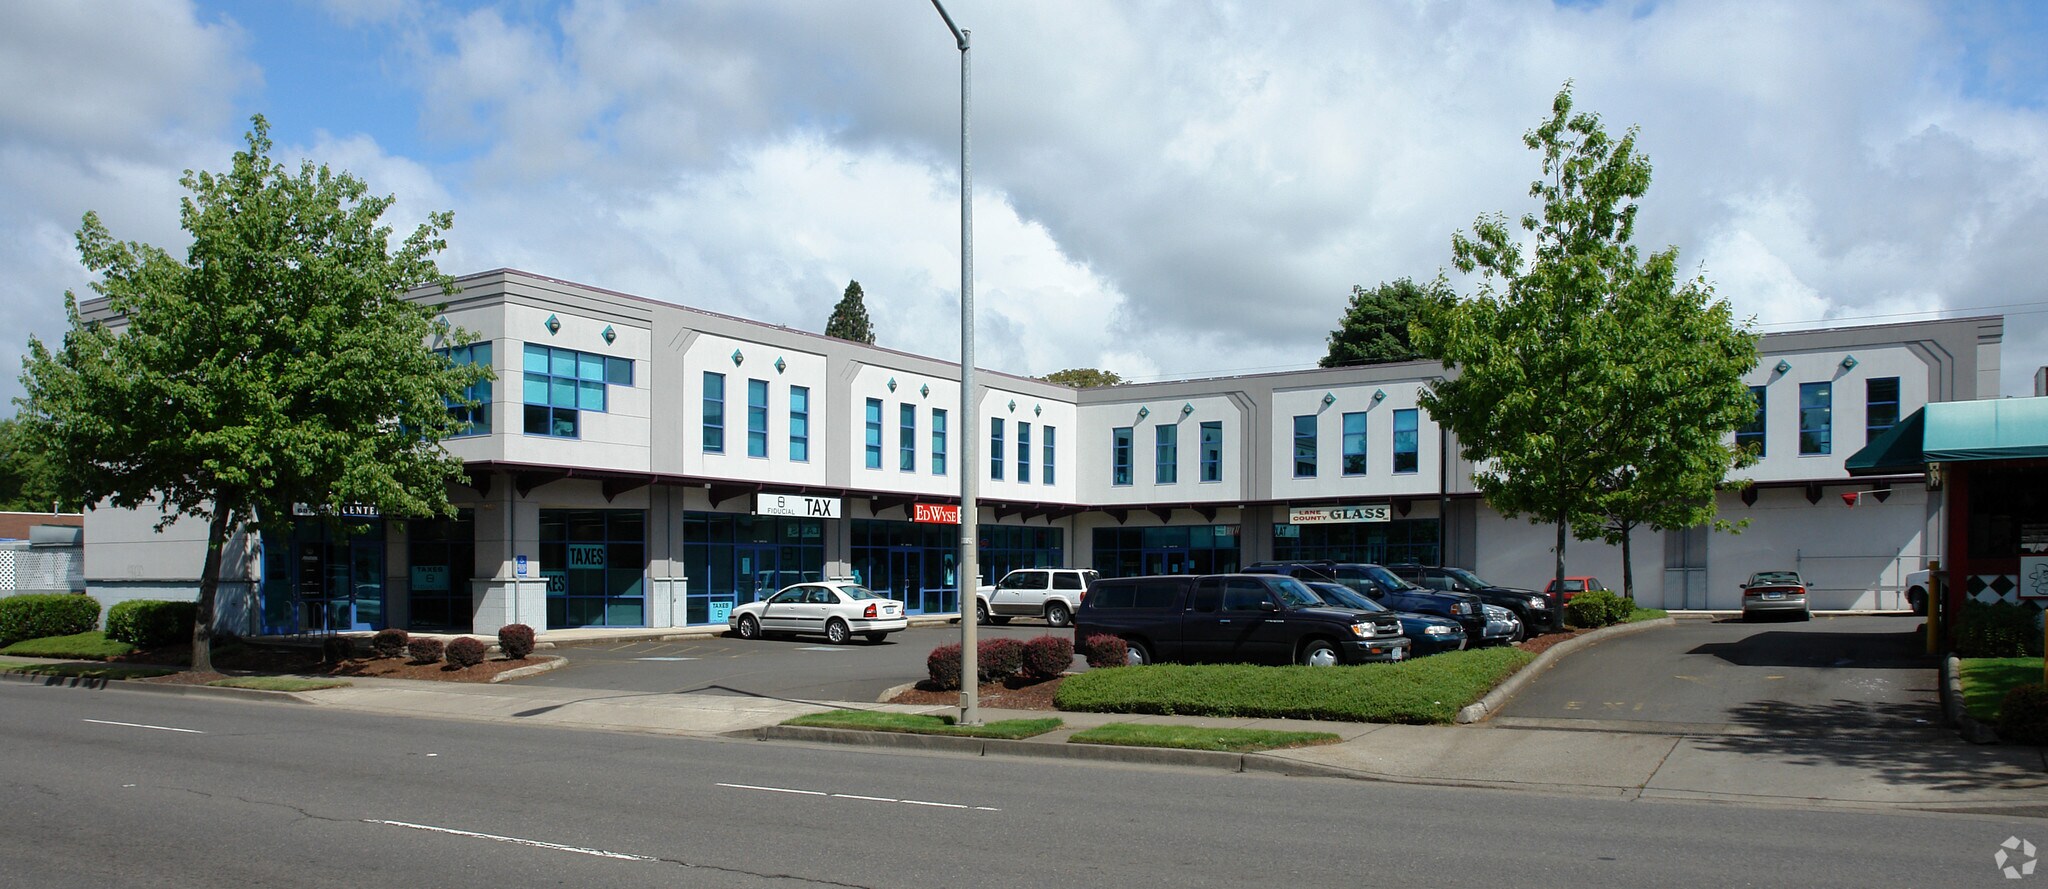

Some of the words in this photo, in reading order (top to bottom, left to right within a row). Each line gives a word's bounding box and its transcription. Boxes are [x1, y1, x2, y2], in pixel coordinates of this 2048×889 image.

[767, 507, 795, 515] FIDUCIAL
[804, 498, 831, 516] TAX
[1330, 508, 1385, 520] GLASS
[570, 548, 604, 565] TAXES
